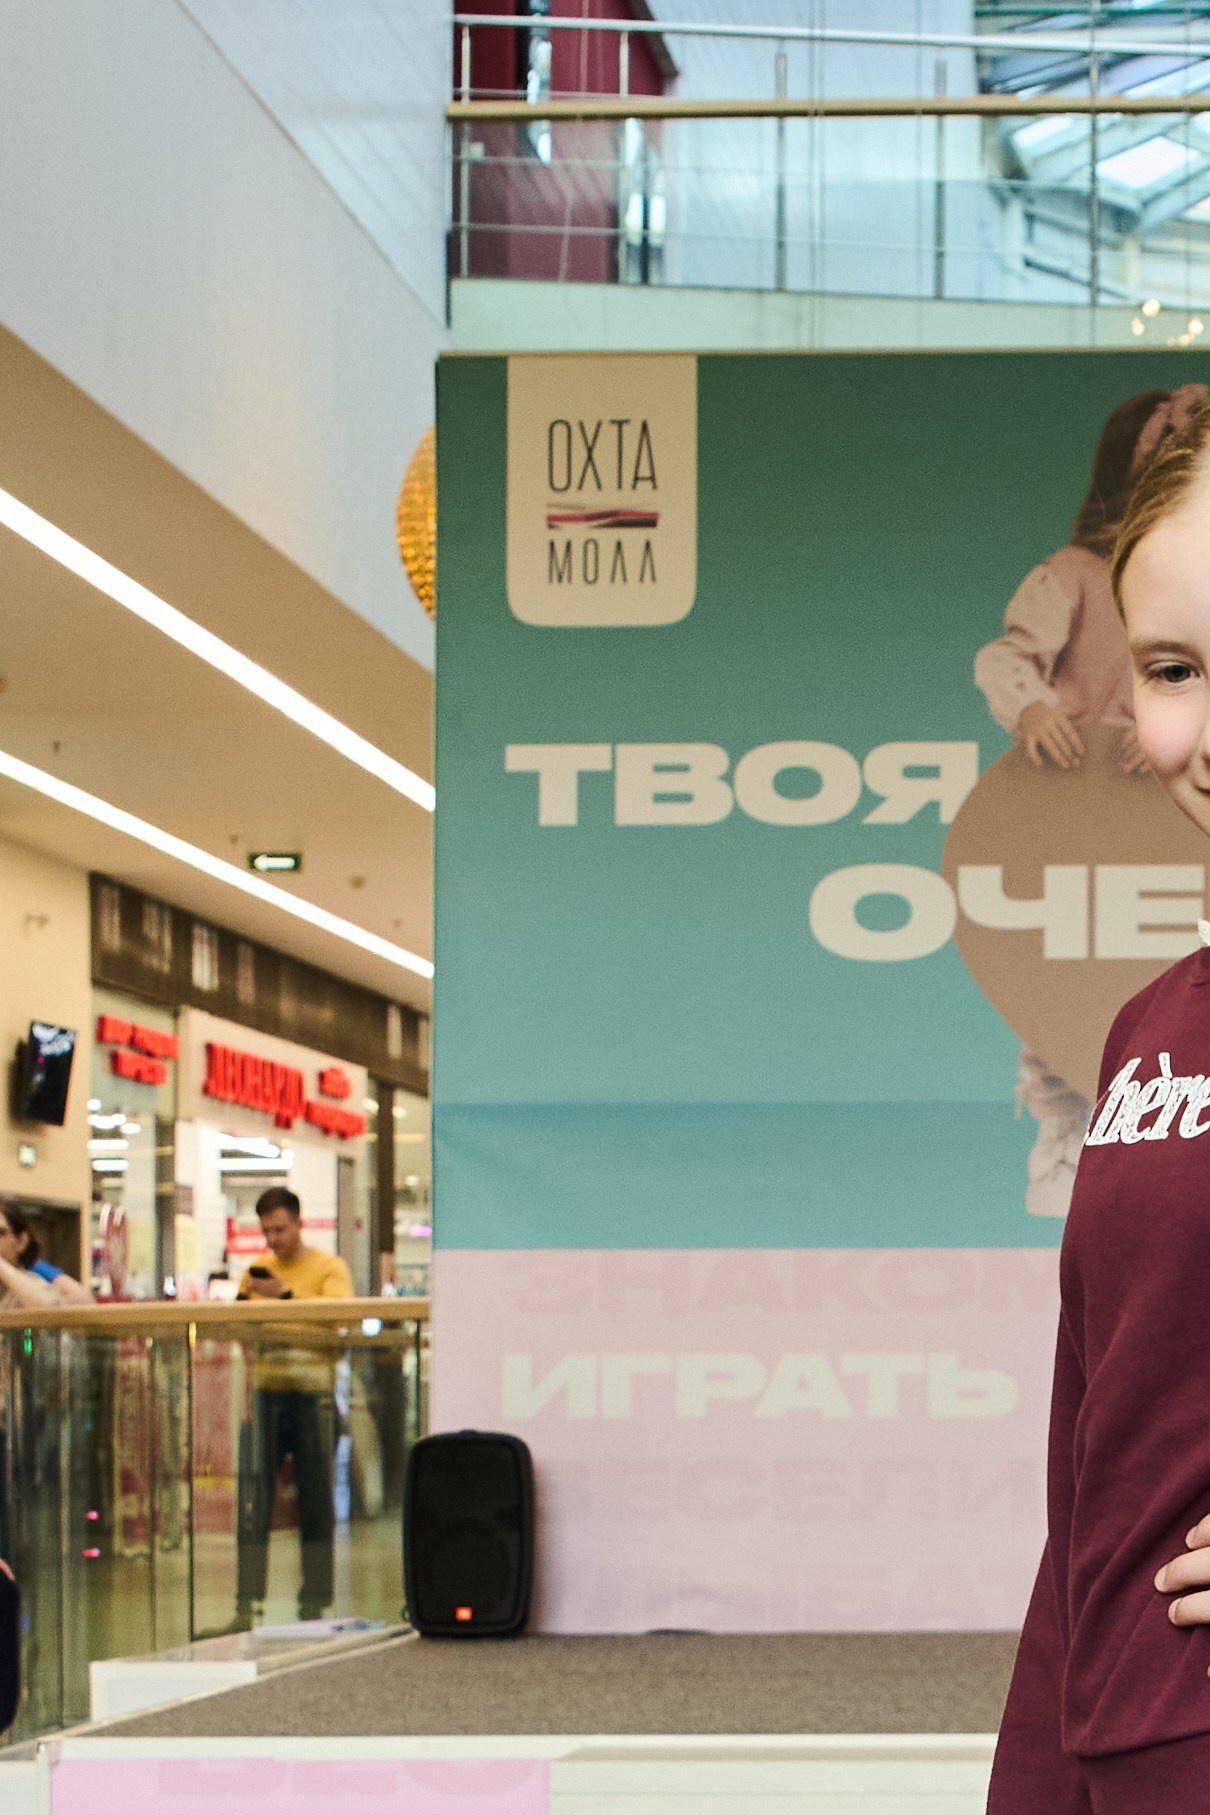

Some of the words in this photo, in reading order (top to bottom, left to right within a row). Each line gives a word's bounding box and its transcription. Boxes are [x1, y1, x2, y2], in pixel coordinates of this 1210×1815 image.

[546, 418, 659, 493] ОХТА
[505, 740, 979, 827] ТВОЯ
[500, 1352, 1021, 1420] ИГРАТЬ
